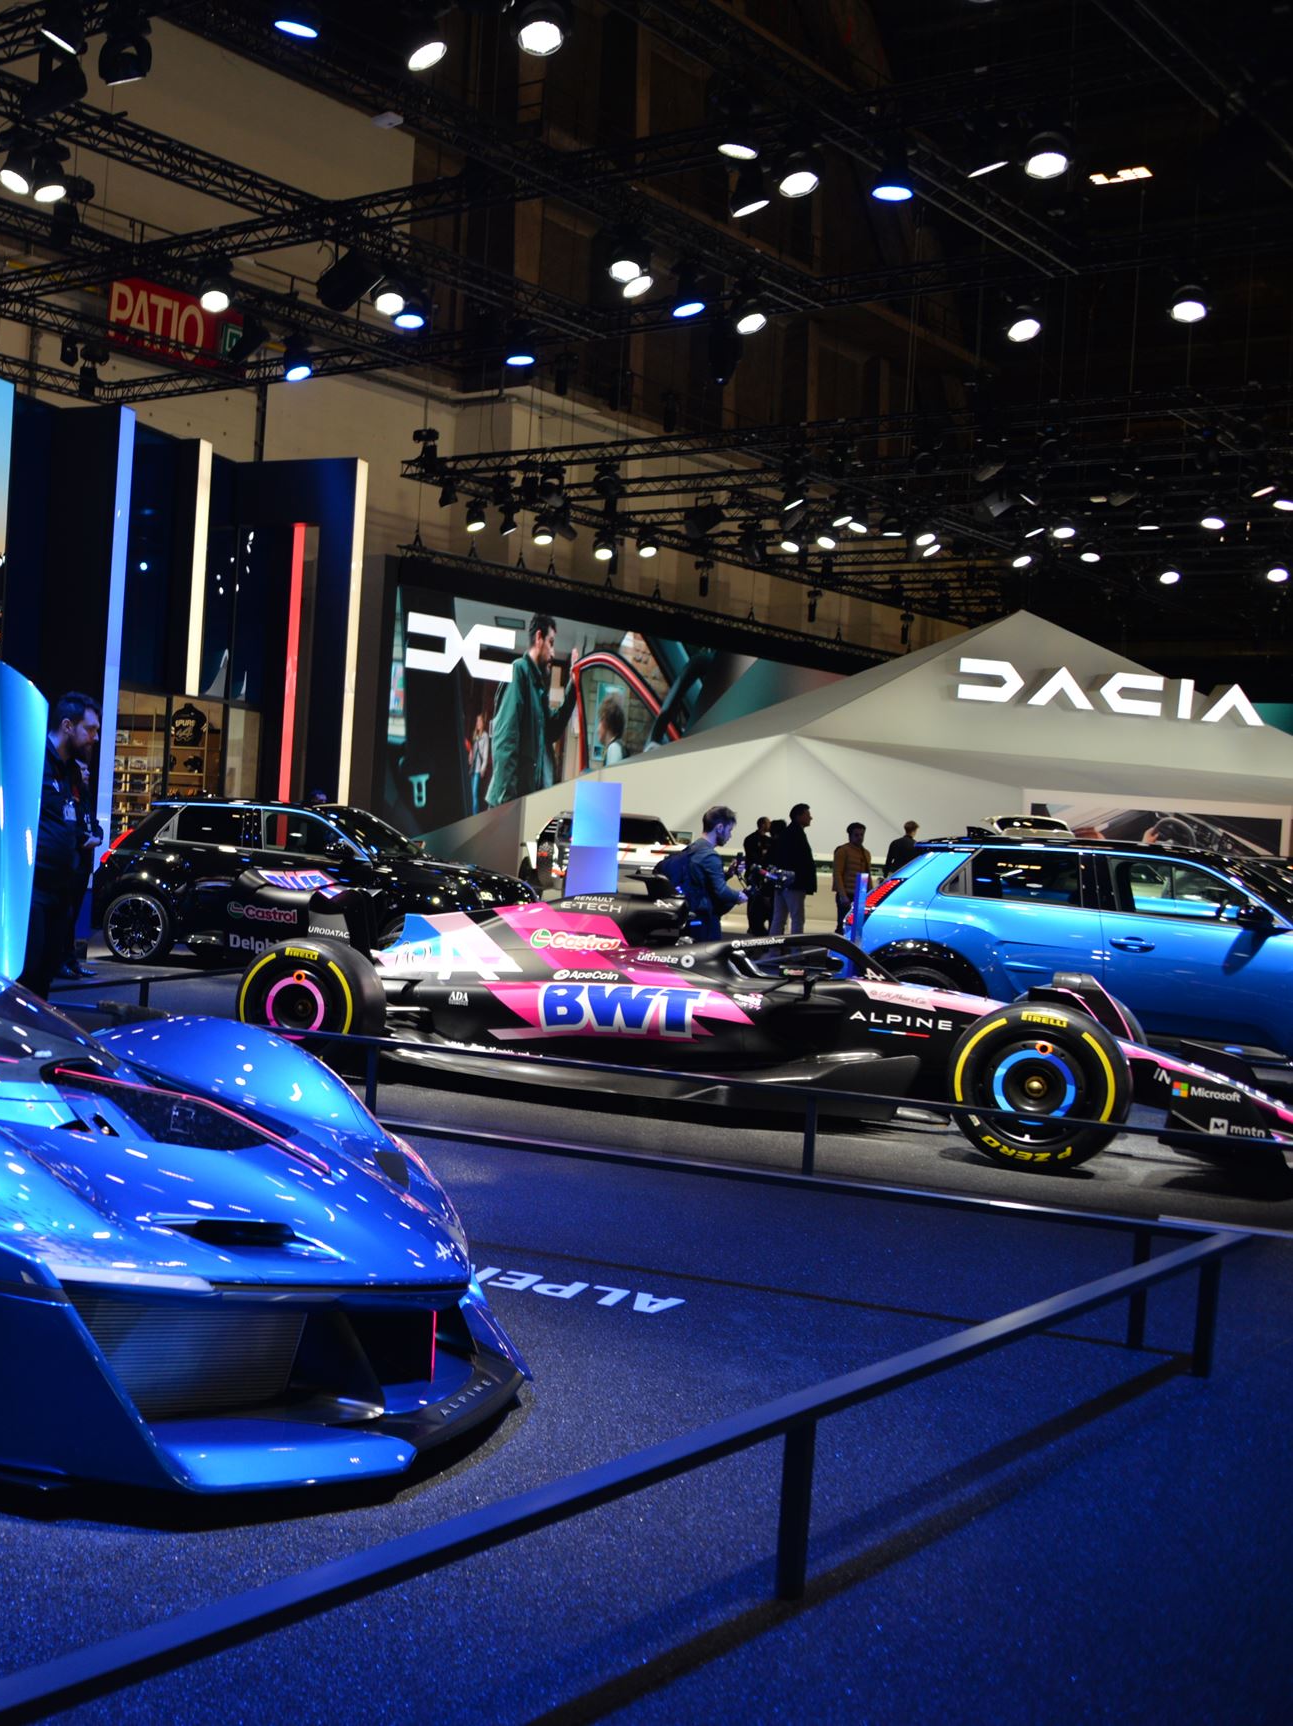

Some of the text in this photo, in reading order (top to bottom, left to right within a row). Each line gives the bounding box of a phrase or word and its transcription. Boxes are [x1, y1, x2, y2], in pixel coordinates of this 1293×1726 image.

[109, 281, 204, 361] PATIO
[957, 657, 1265, 726] DACIA
[560, 901, 622, 914] E-TECH
[573, 895, 615, 903] RENAULT
[243, 903, 298, 924] Castrol
[229, 933, 280, 955] Delph
[549, 931, 621, 950] Castrol
[284, 947, 319, 961] PIRELLI
[569, 971, 619, 981] ApeCoin
[539, 982, 701, 1038] BWT
[1021, 1011, 1068, 1028] PIRELLI
[849, 1010, 953, 1031] ALPINE
[1190, 1086, 1241, 1103] Microsoft
[1230, 1125, 1266, 1138] mntn
[981, 1135, 1073, 1162] P ZERO
[440, 1380, 492, 1417] ALPINE
